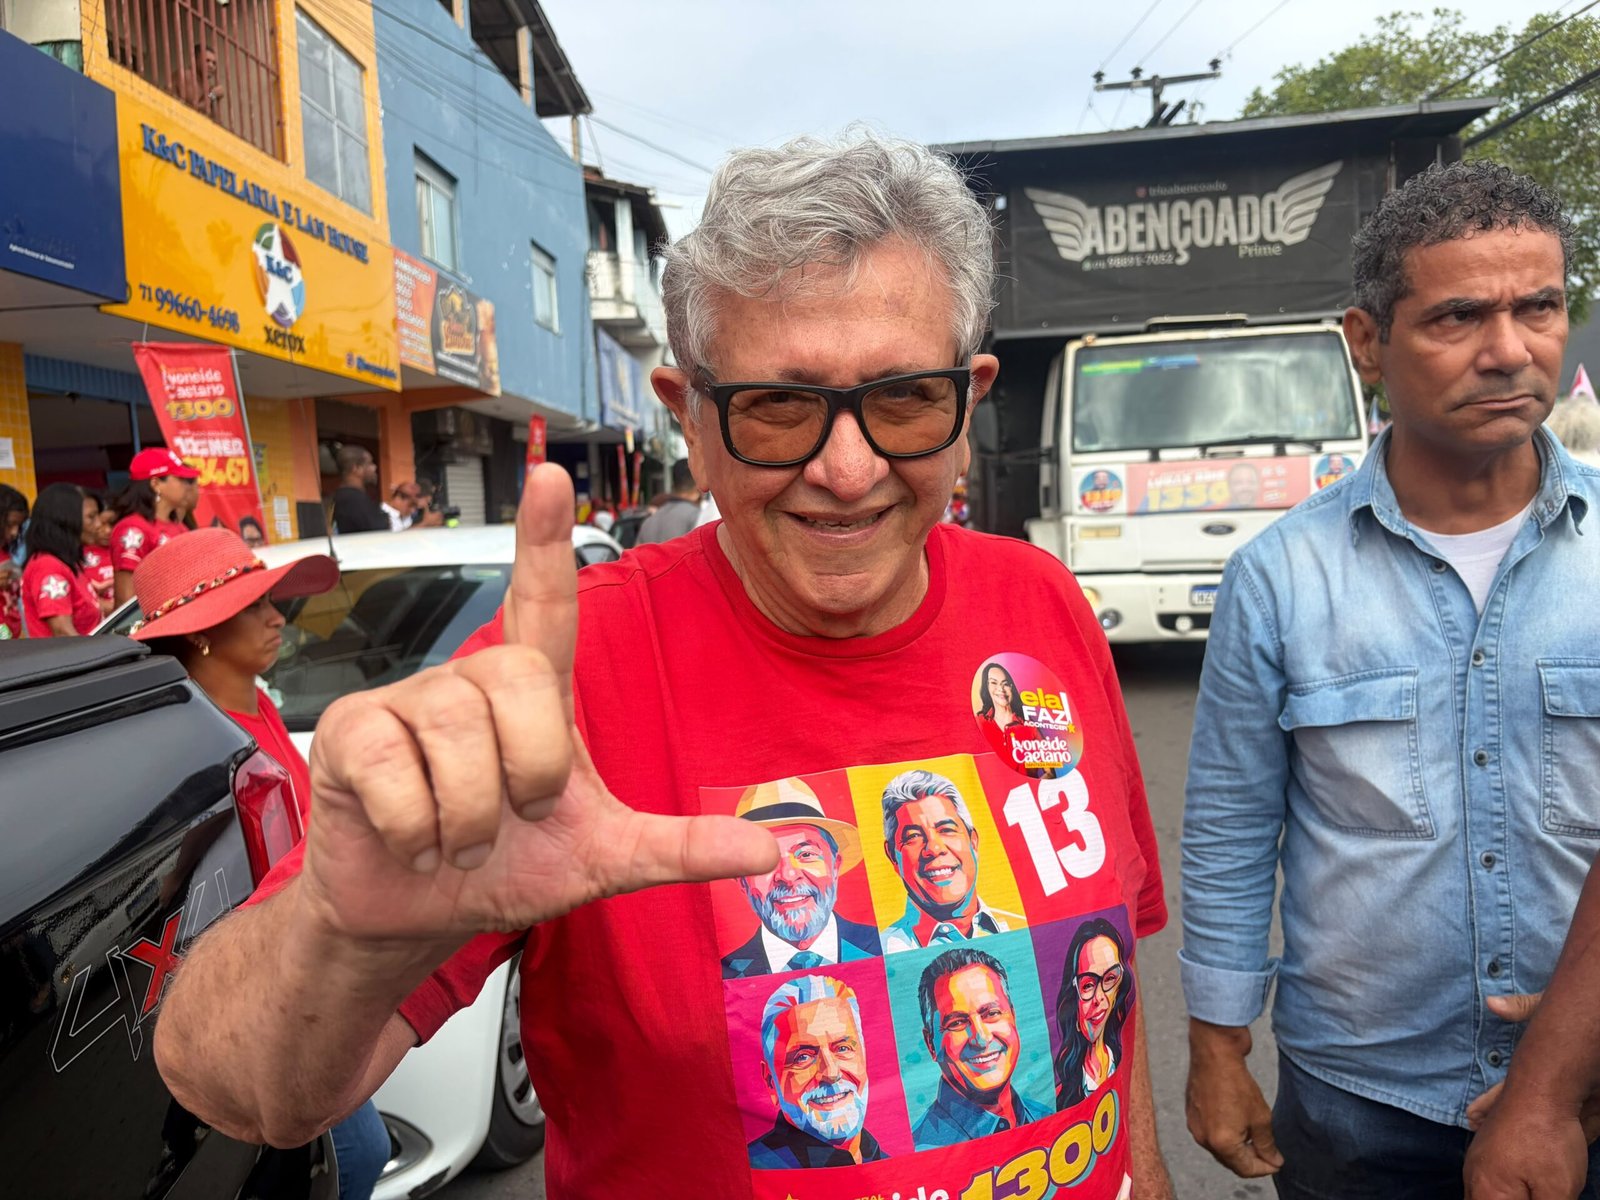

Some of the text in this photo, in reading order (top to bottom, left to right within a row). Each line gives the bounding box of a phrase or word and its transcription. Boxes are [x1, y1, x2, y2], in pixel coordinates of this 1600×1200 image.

[140, 123, 370, 265] K&C PAPELARIA E LAN HOUSE
[1084, 192, 1284, 266] ABENÇOADO
[1238, 244, 1283, 259] Prime
[265, 254, 293, 283] K&C
[139, 284, 153, 302] 71
[264, 326, 307, 354] xerox
[1023, 720, 1069, 732] ACONTECER
[1011, 736, 1068, 752] Ivoneide
[1012, 747, 1071, 764] Caetano
[1002, 767, 1107, 897] 13
[957, 1089, 1120, 1200] 1300
